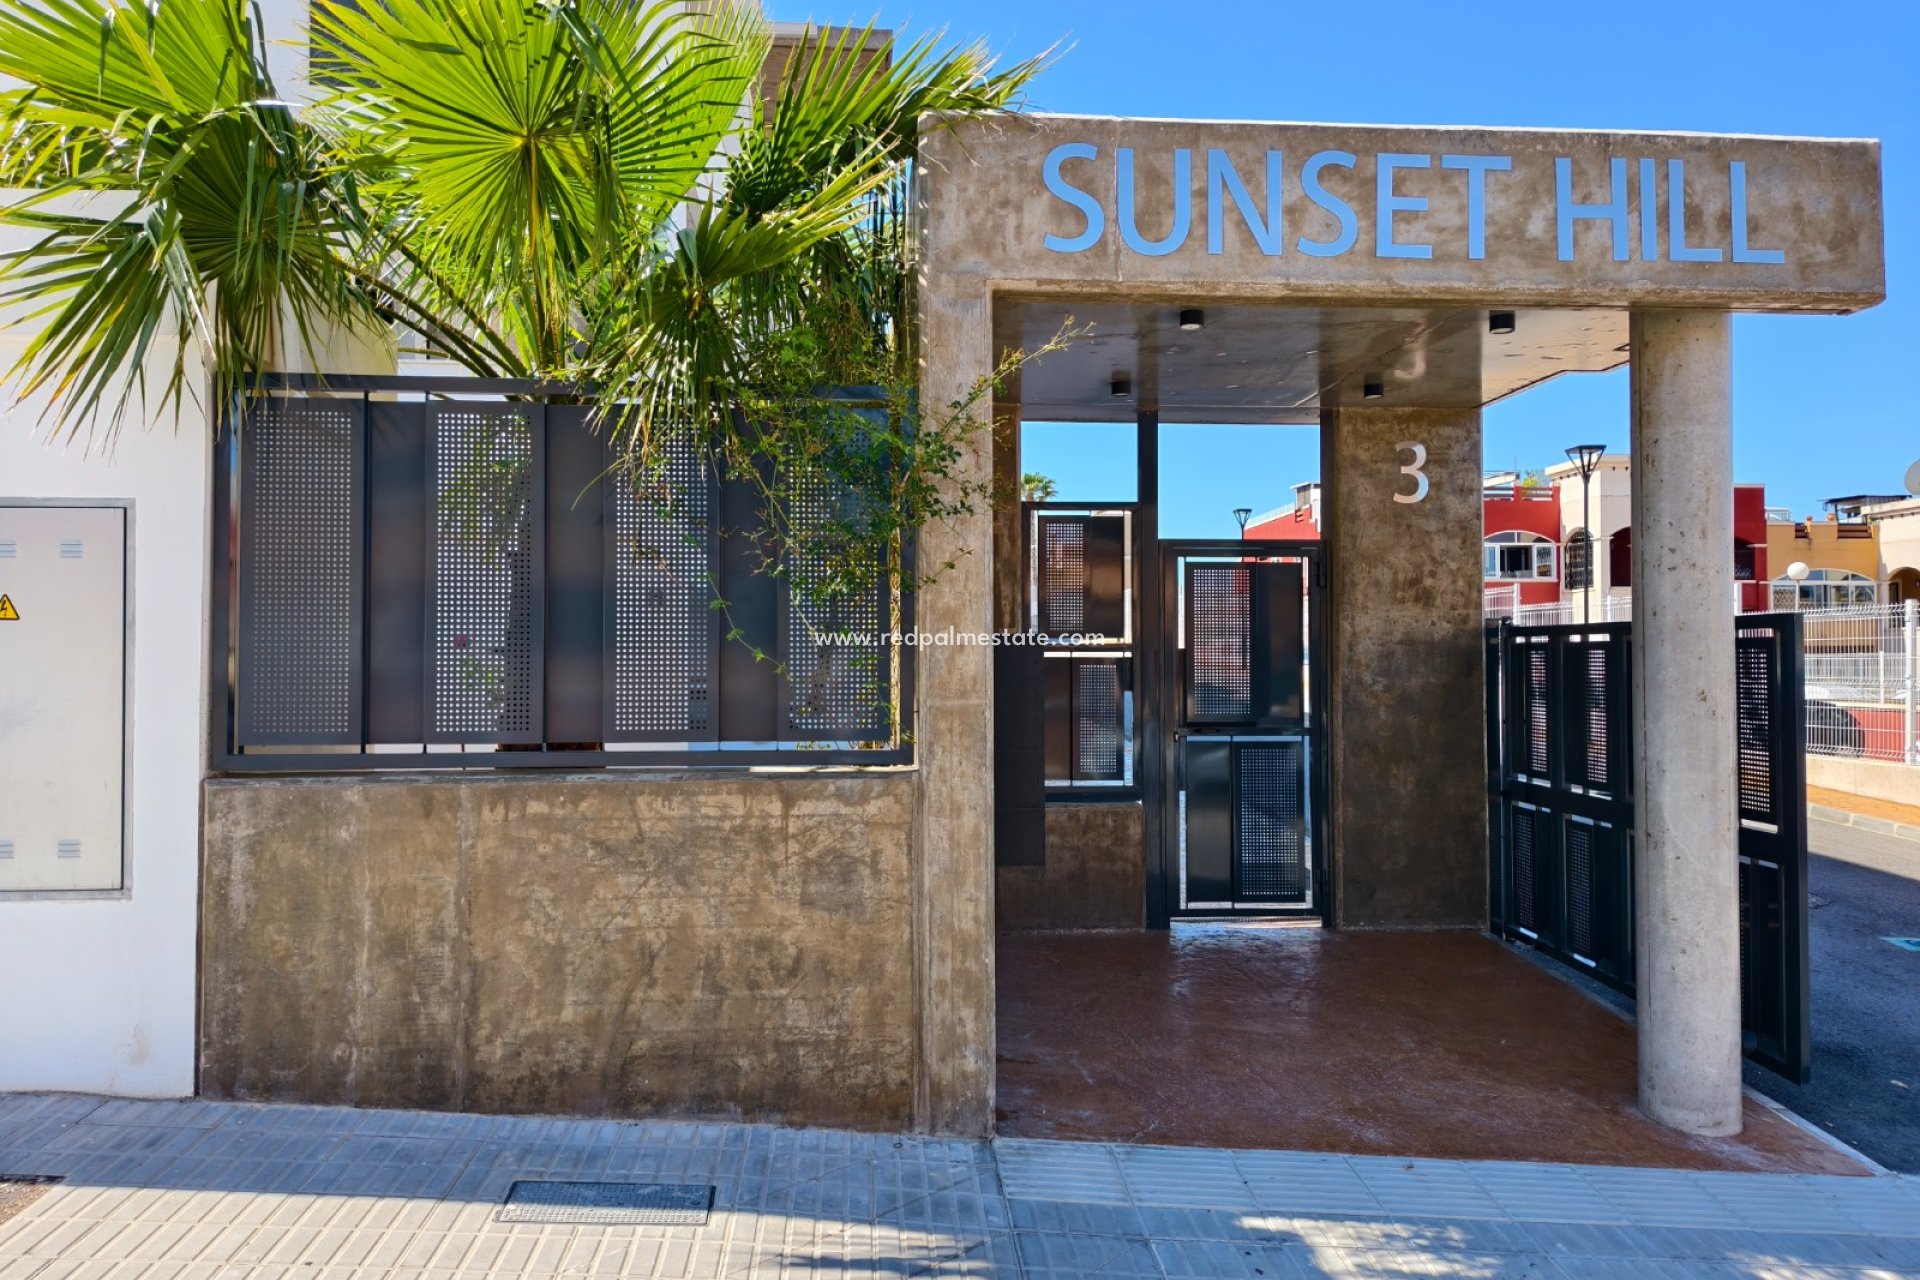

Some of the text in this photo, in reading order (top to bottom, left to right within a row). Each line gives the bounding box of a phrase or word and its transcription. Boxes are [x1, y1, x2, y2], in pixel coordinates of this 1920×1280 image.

[1042, 141, 1786, 265] SUNSET HILL
[1392, 440, 1430, 505] 3
